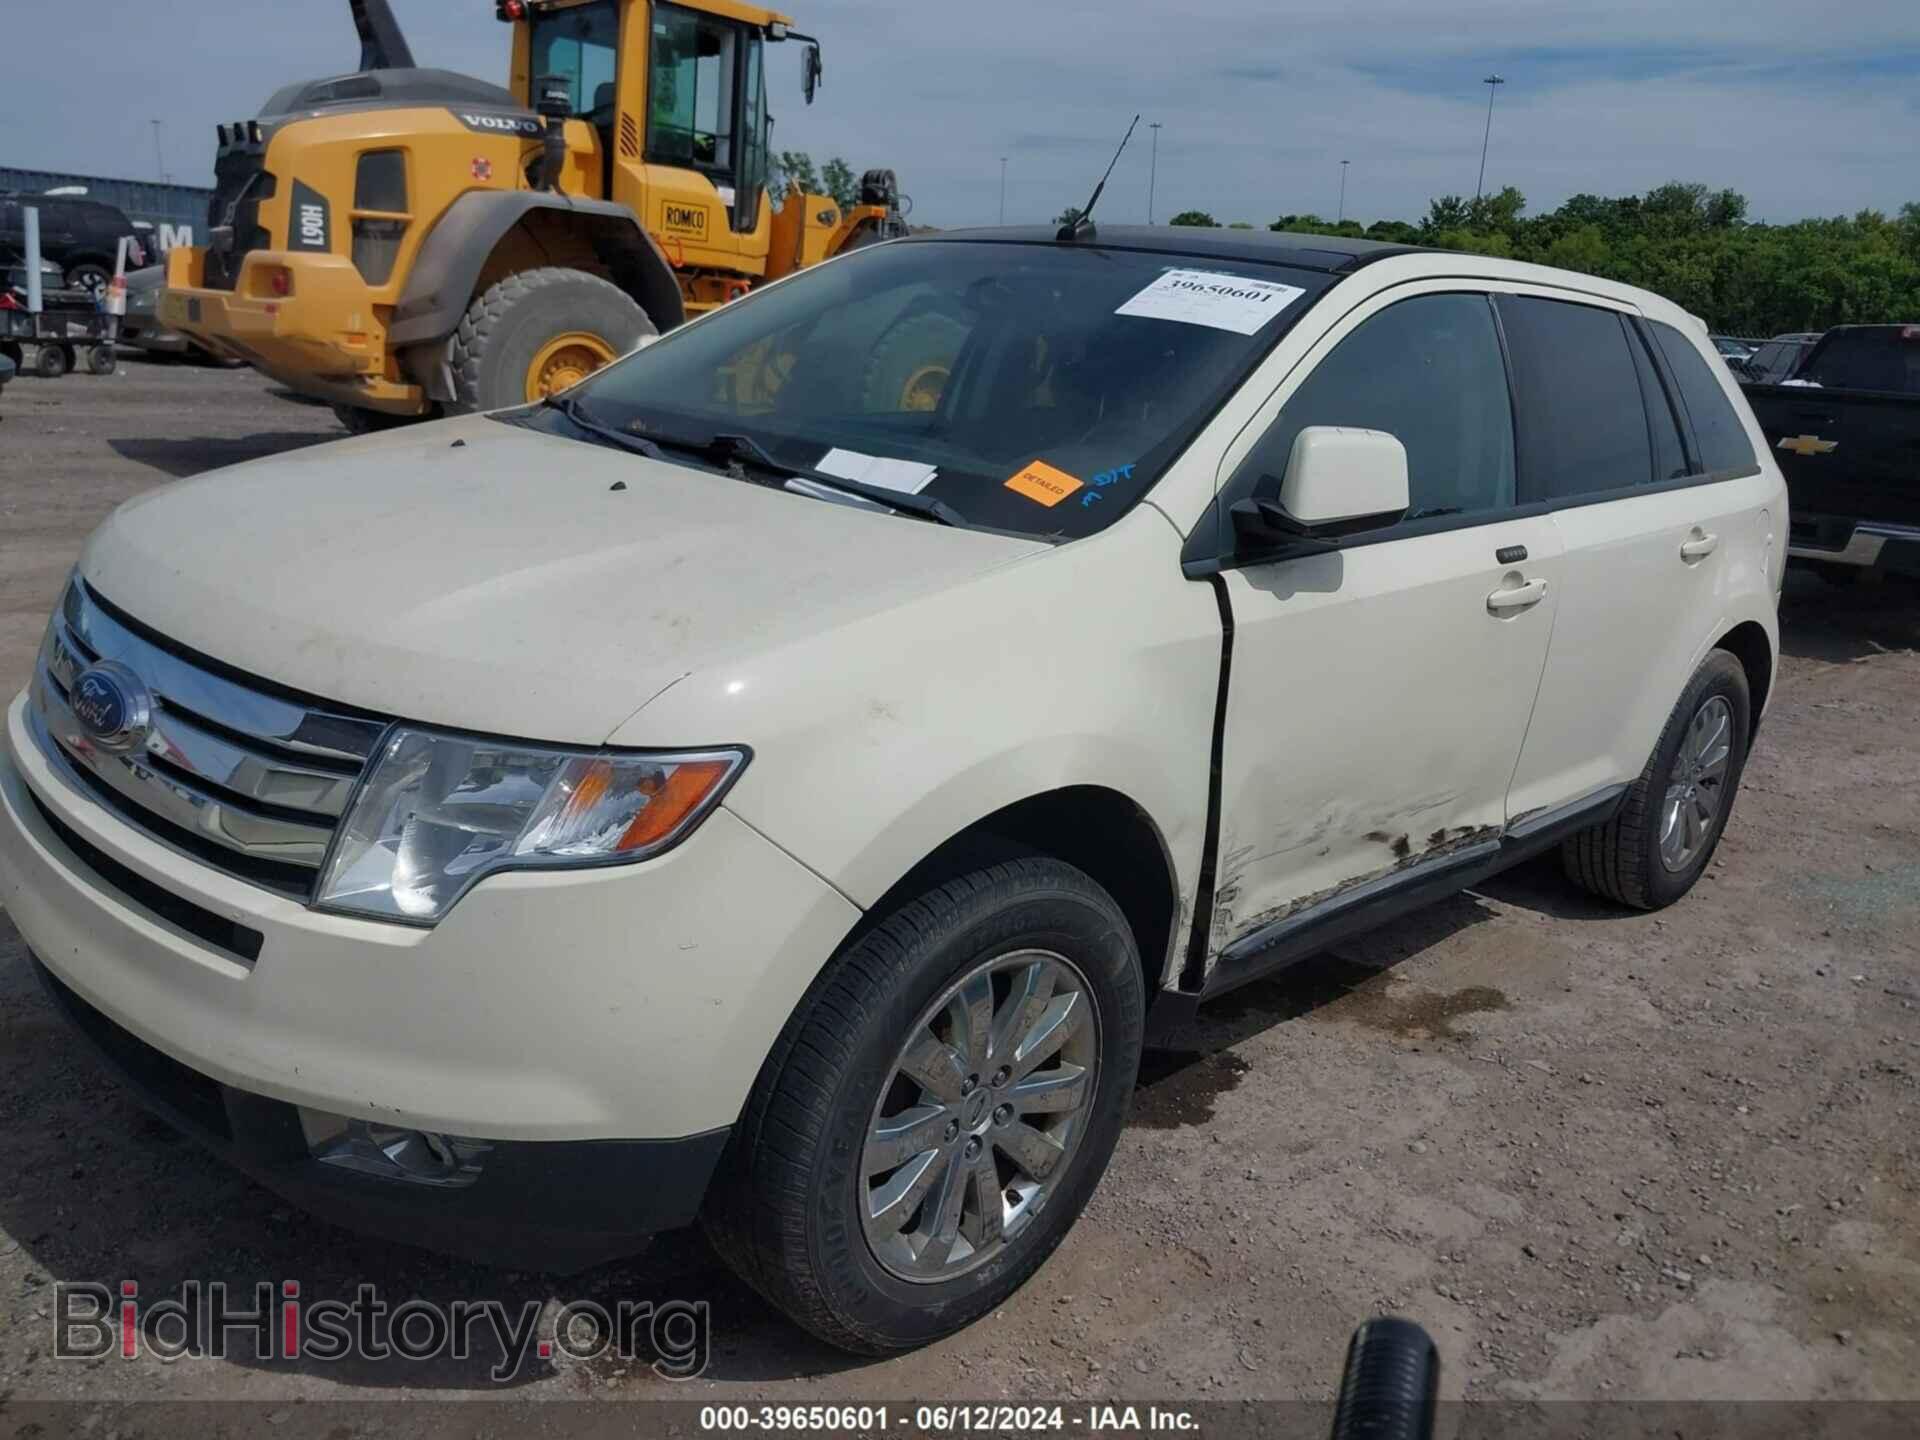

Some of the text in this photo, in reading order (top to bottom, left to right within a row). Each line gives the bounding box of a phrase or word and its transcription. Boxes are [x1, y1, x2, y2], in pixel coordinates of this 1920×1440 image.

[463, 114, 538, 132] VOLVO
[301, 205, 324, 246] L90H
[667, 207, 704, 229] ROMCO
[1170, 280, 1272, 303] 39650601
[1022, 472, 1065, 495] DETAILED
